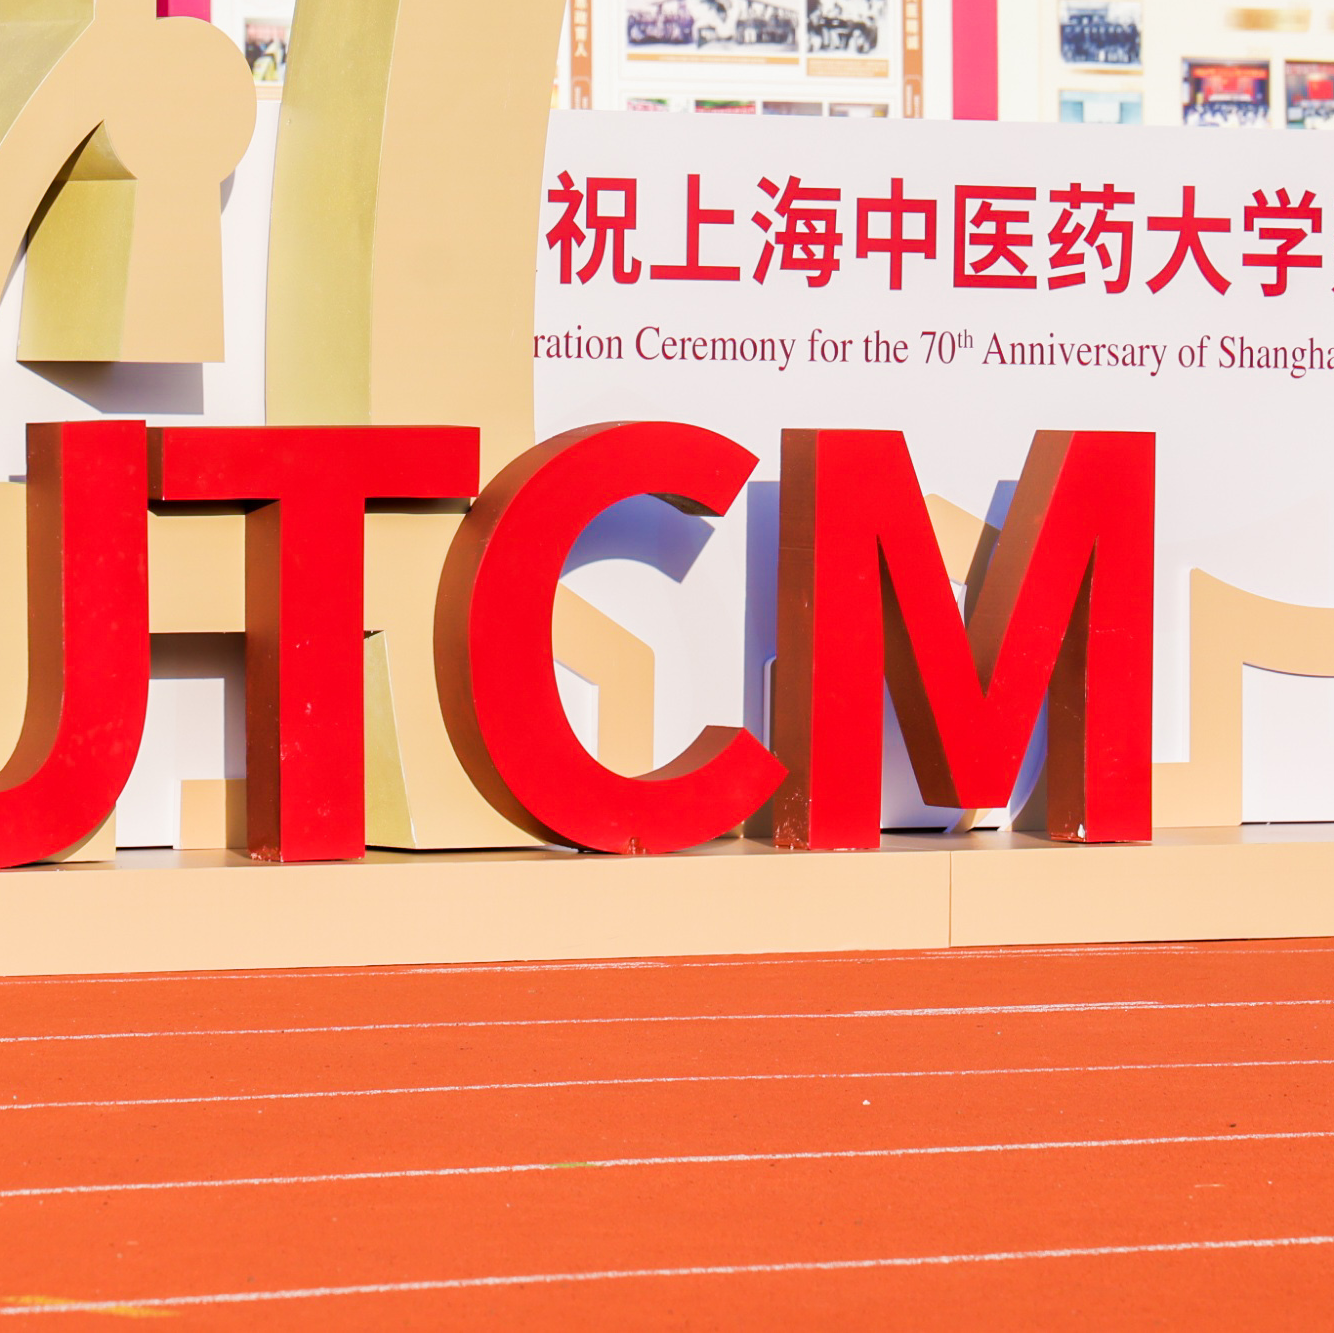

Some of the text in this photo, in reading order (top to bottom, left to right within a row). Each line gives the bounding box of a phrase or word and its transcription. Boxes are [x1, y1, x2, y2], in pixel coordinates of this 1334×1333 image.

[635, 326, 797, 372] Ceremony
[807, 329, 854, 363] for
[863, 330, 909, 364] the
[919, 329, 974, 365] 70th
[983, 332, 1167, 377] Anniversary
[1178, 335, 1210, 369] of
